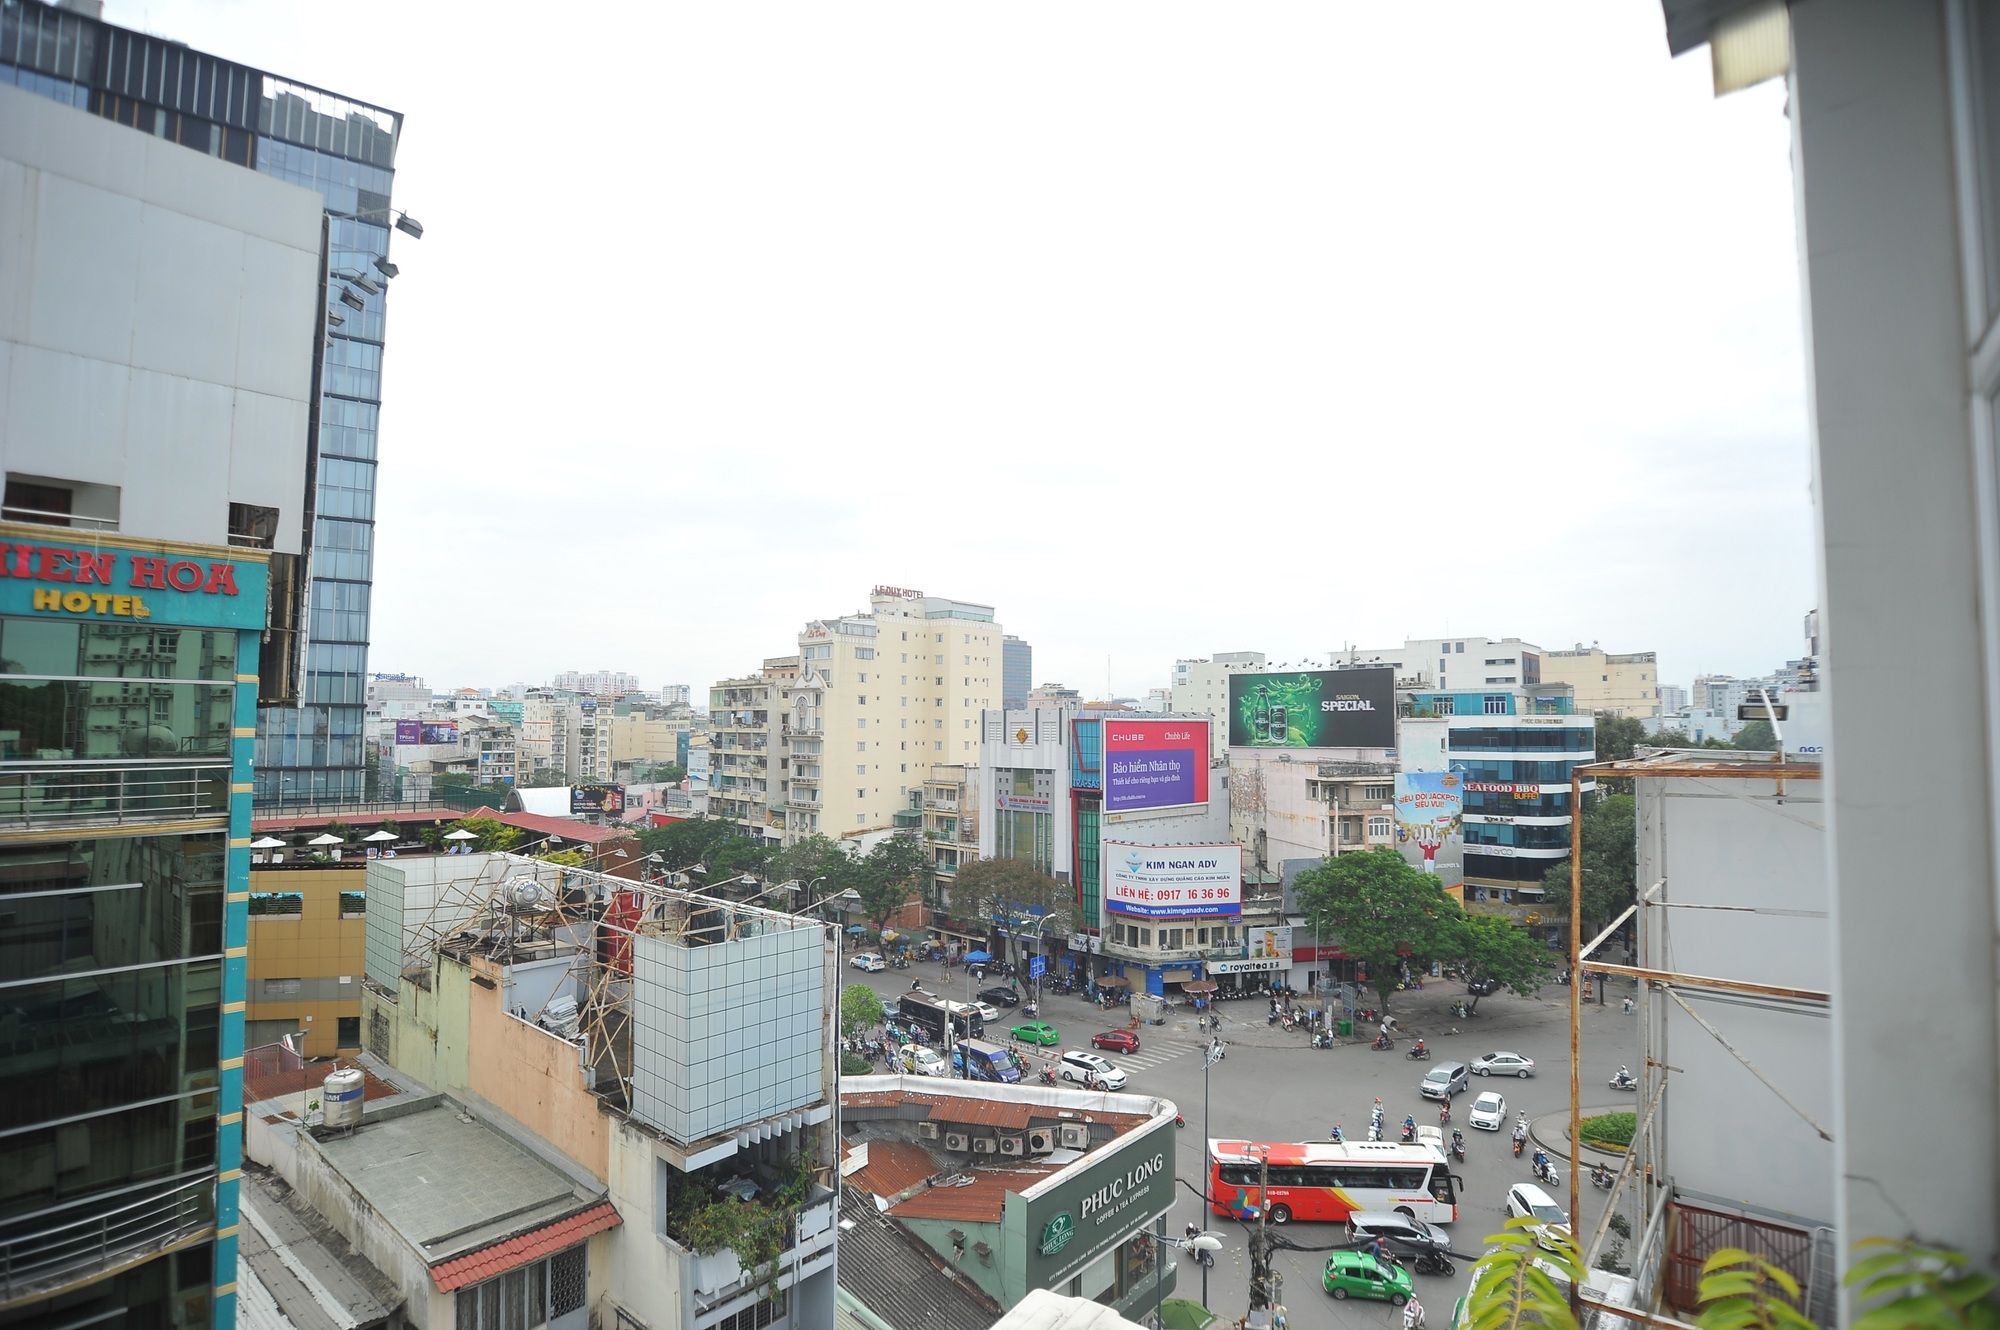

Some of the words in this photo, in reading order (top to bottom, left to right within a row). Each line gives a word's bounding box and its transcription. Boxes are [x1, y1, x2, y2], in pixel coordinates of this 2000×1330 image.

[129, 556, 240, 596] HOA
[886, 586, 901, 596] DUY
[902, 589, 923, 599] HOTEL
[33, 588, 151, 617] HOTEL
[1321, 700, 1375, 712] SPECIAL
[1164, 732, 1181, 740] Chubb
[1181, 732, 1191, 740] Life
[1113, 761, 1128, 774] Bảo
[1129, 759, 1148, 773] hiểm
[1169, 760, 1180, 773] thọ
[1463, 784, 1513, 794] SEAFOOD
[1515, 784, 1539, 794] BBQ
[1429, 793, 1460, 802] JACKPOT
[1513, 792, 1540, 800] BUFFET
[1146, 861, 1165, 870] KIM
[1168, 860, 1195, 869] NGAN
[1198, 860, 1218, 869] ADV
[1115, 885, 1136, 899] LIÊN
[1138, 887, 1154, 902] HỆ:
[1157, 889, 1181, 900] 0917
[1188, 889, 1198, 899] 16
[1201, 888, 1214, 899] 36
[1217, 887, 1230, 898] 96
[1125, 904, 1149, 914] Website:
[1150, 905, 1219, 916] www.kimnganadv.com
[1229, 962, 1268, 974] royaltea
[1080, 1178, 1124, 1220] PHUC
[1126, 1153, 1164, 1191] LONG
[1095, 1208, 1115, 1226] COFFEE
[1120, 1200, 1129, 1212] TEA
[1129, 1185, 1150, 1204] EXPRESS
[1059, 1229, 1074, 1243] LONG
